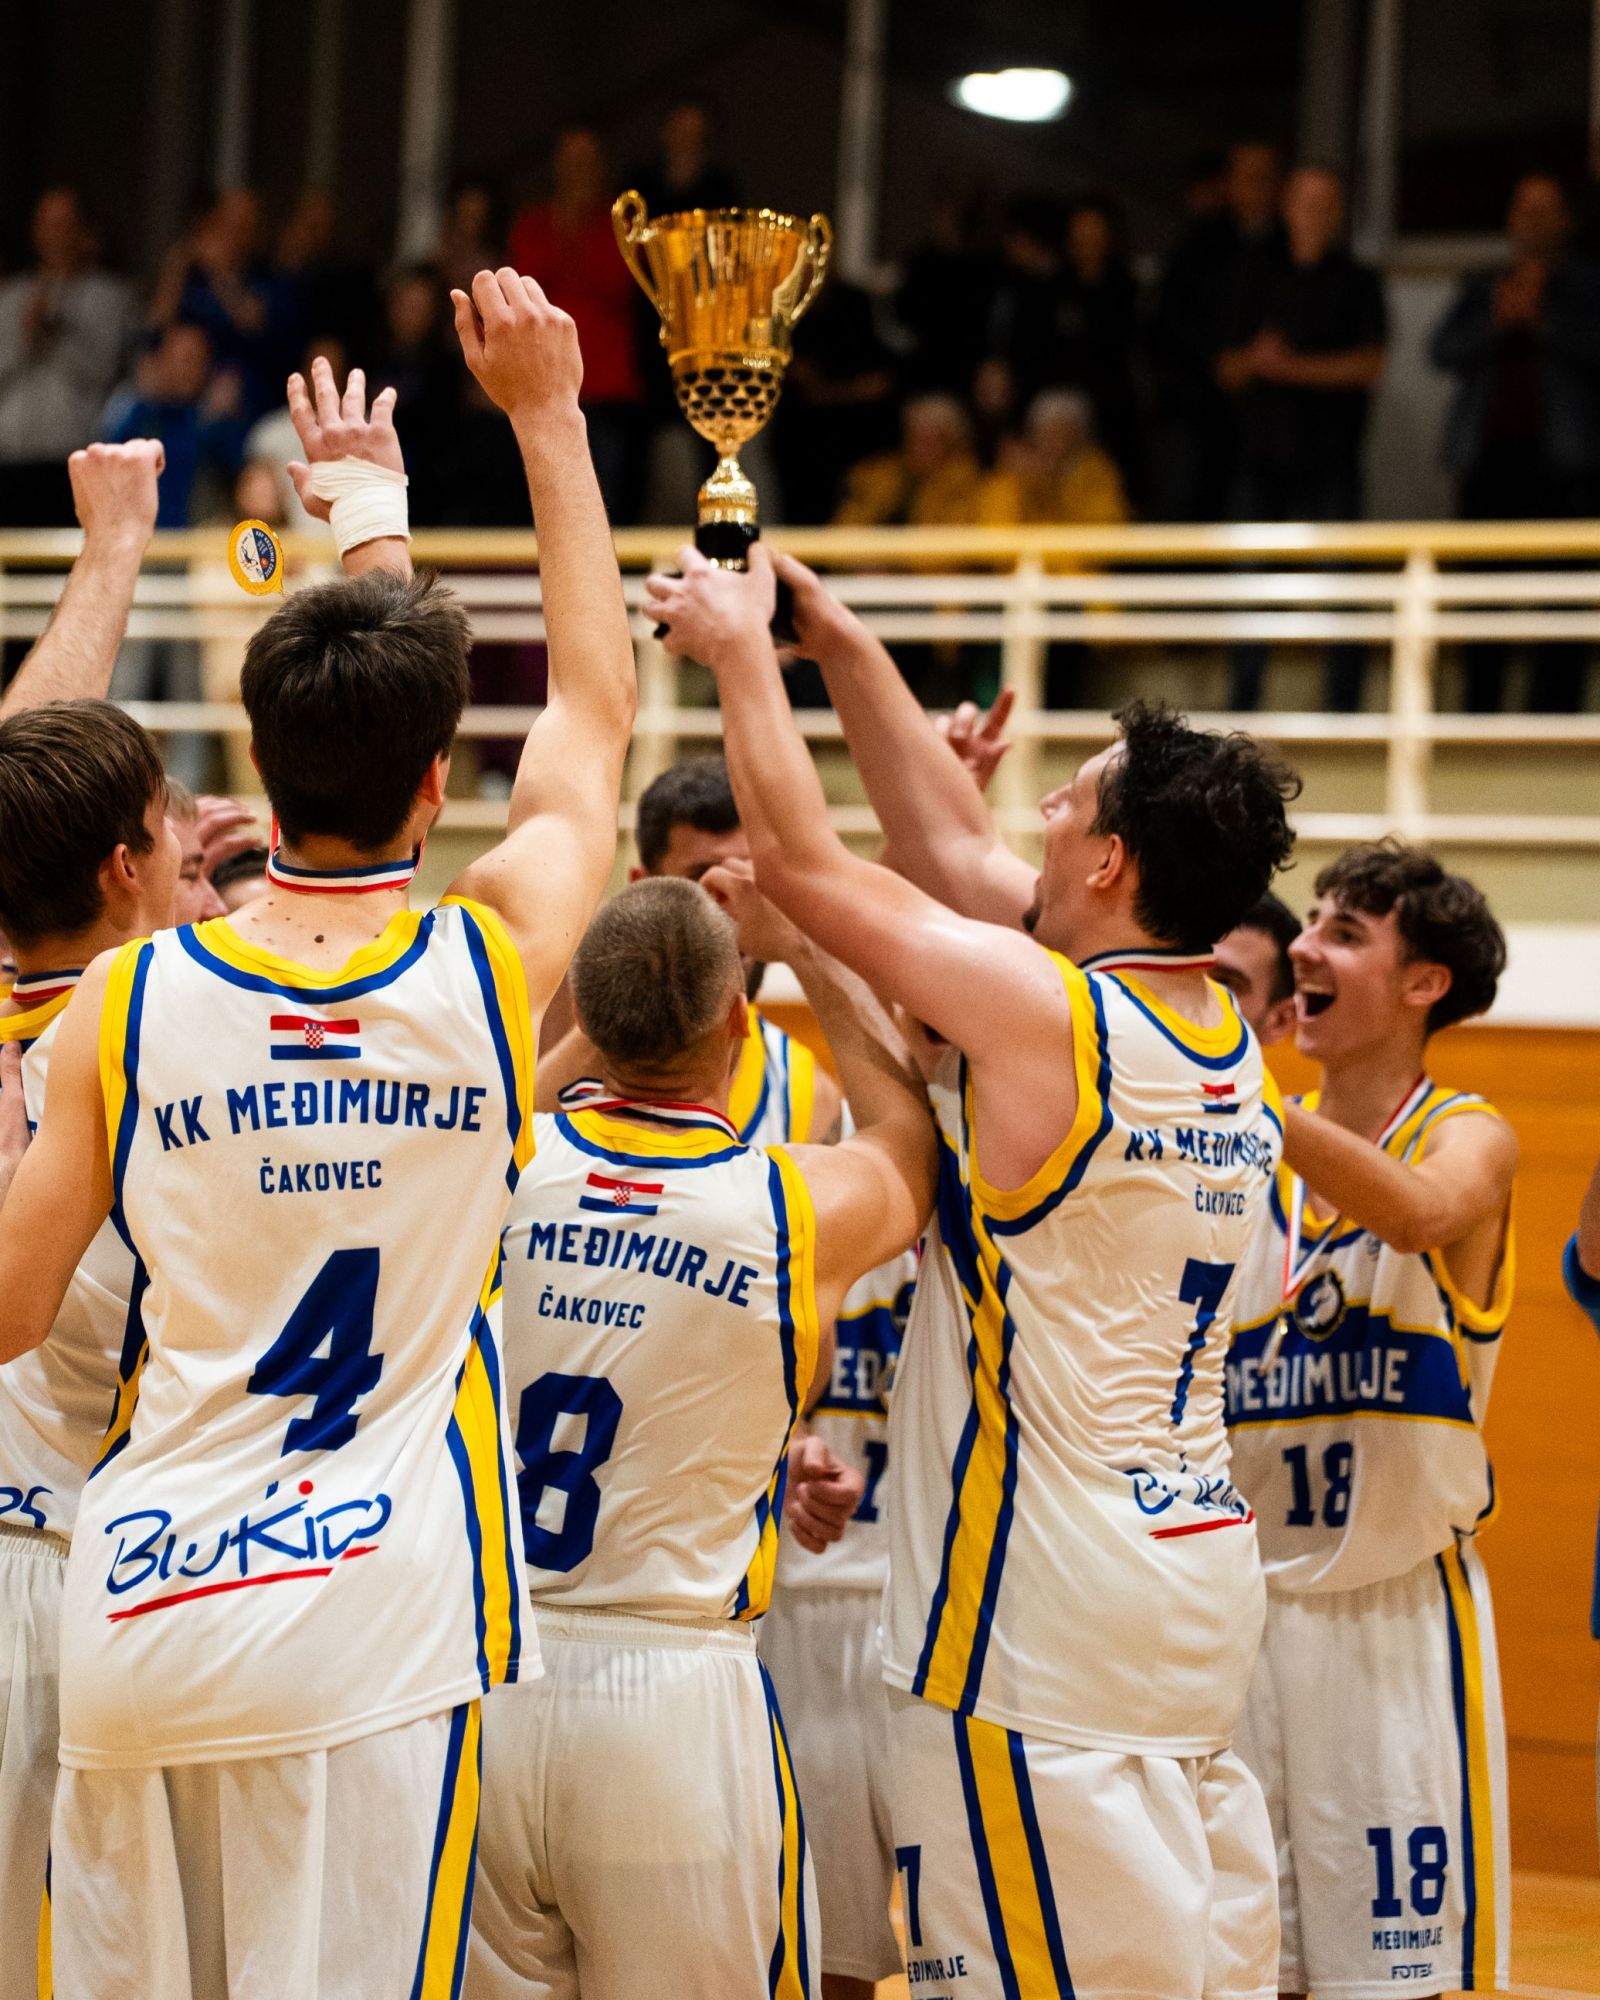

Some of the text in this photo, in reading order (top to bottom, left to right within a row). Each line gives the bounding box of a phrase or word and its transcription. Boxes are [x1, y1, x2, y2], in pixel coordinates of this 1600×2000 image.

[154, 1079, 486, 1151] KK MEĐIMURJE
[260, 1157, 382, 1194] ČAKOVEC
[527, 1222, 760, 1308] MEĐIMURJE
[538, 1284, 646, 1329] ČAKOVEC
[246, 1247, 385, 1458] 4
[1170, 1257, 1236, 1426] 7
[515, 1371, 624, 1573] 8
[1281, 1441, 1354, 1527] 18
[1366, 1826, 1448, 1918] 18
